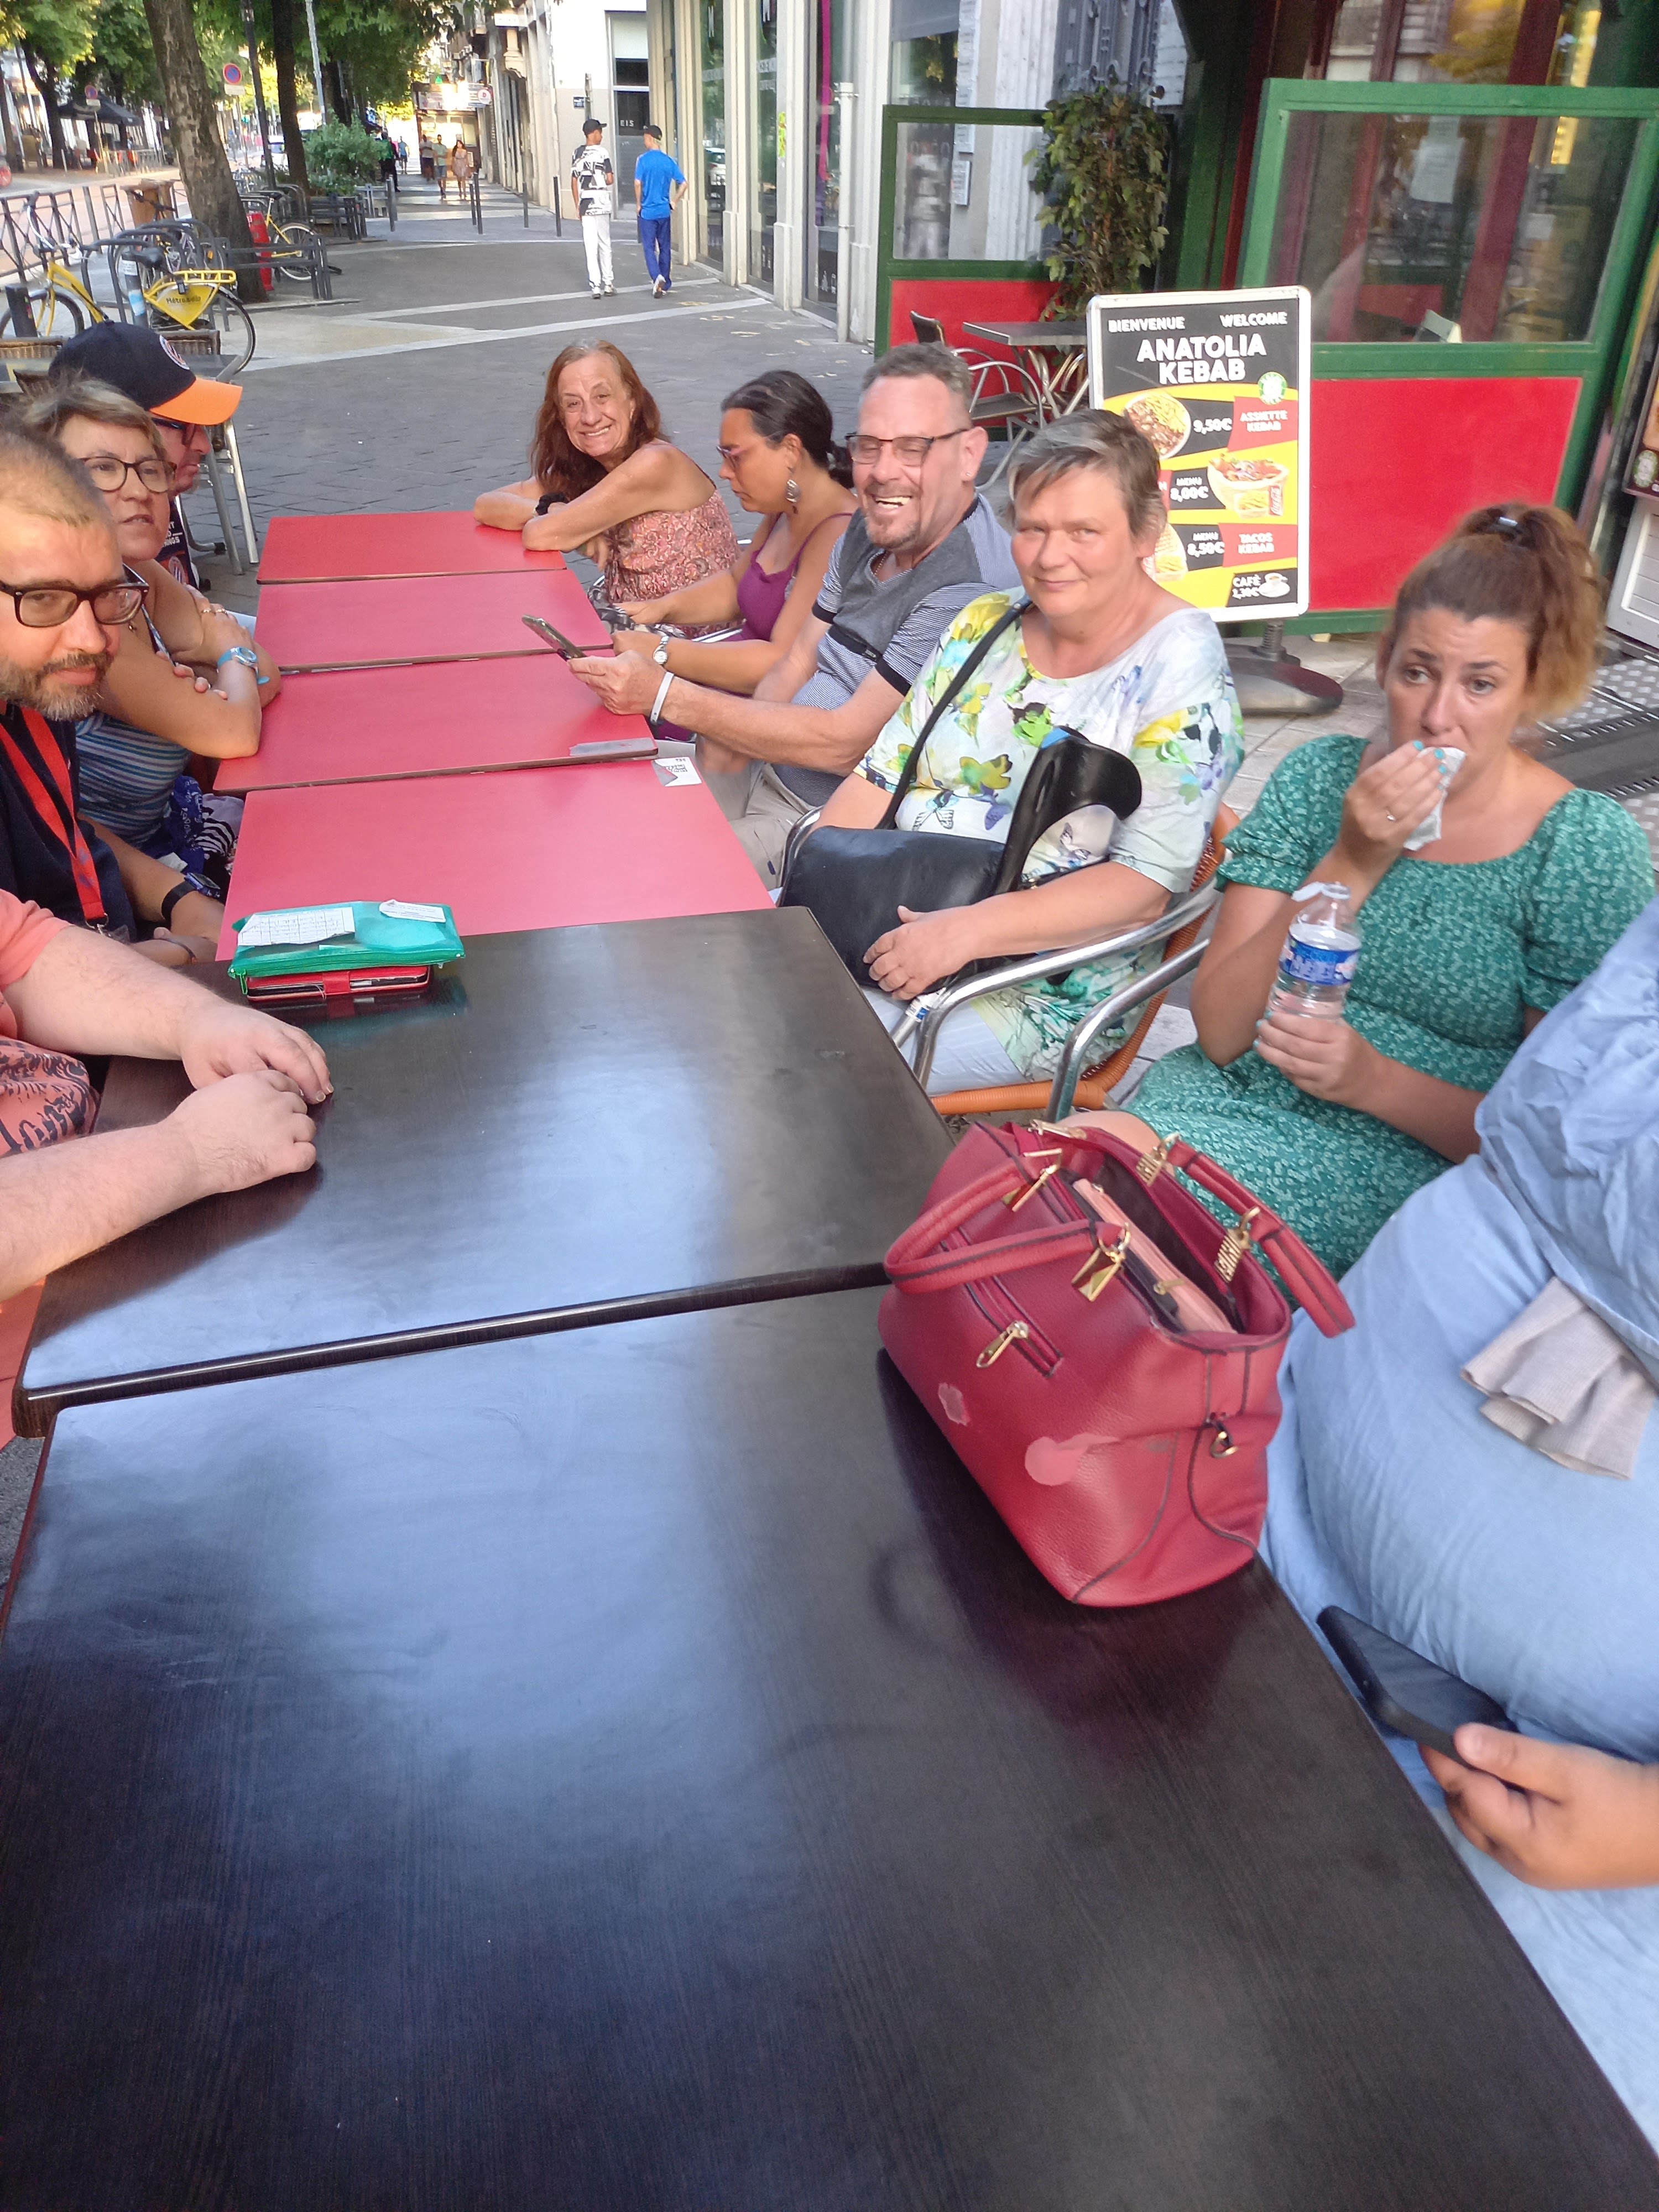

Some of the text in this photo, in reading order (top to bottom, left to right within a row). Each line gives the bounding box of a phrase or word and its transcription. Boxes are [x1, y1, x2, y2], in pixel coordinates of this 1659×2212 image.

[1108, 316, 1185, 332] BIENVENUE
[1219, 311, 1287, 327] WELCOME
[1136, 333, 1267, 363] ANATOLIA
[1159, 358, 1246, 385] KEBAB
[1240, 409, 1288, 422] ASSIETTE
[1193, 417, 1233, 435] 9,50€
[1246, 421, 1281, 432] KEBAB
[1176, 476, 1202, 487] MENU
[1170, 486, 1209, 503] 8,00€
[1193, 531, 1219, 541] MENU
[1238, 532, 1274, 544] TACOS
[1238, 542, 1275, 554] KEBAB
